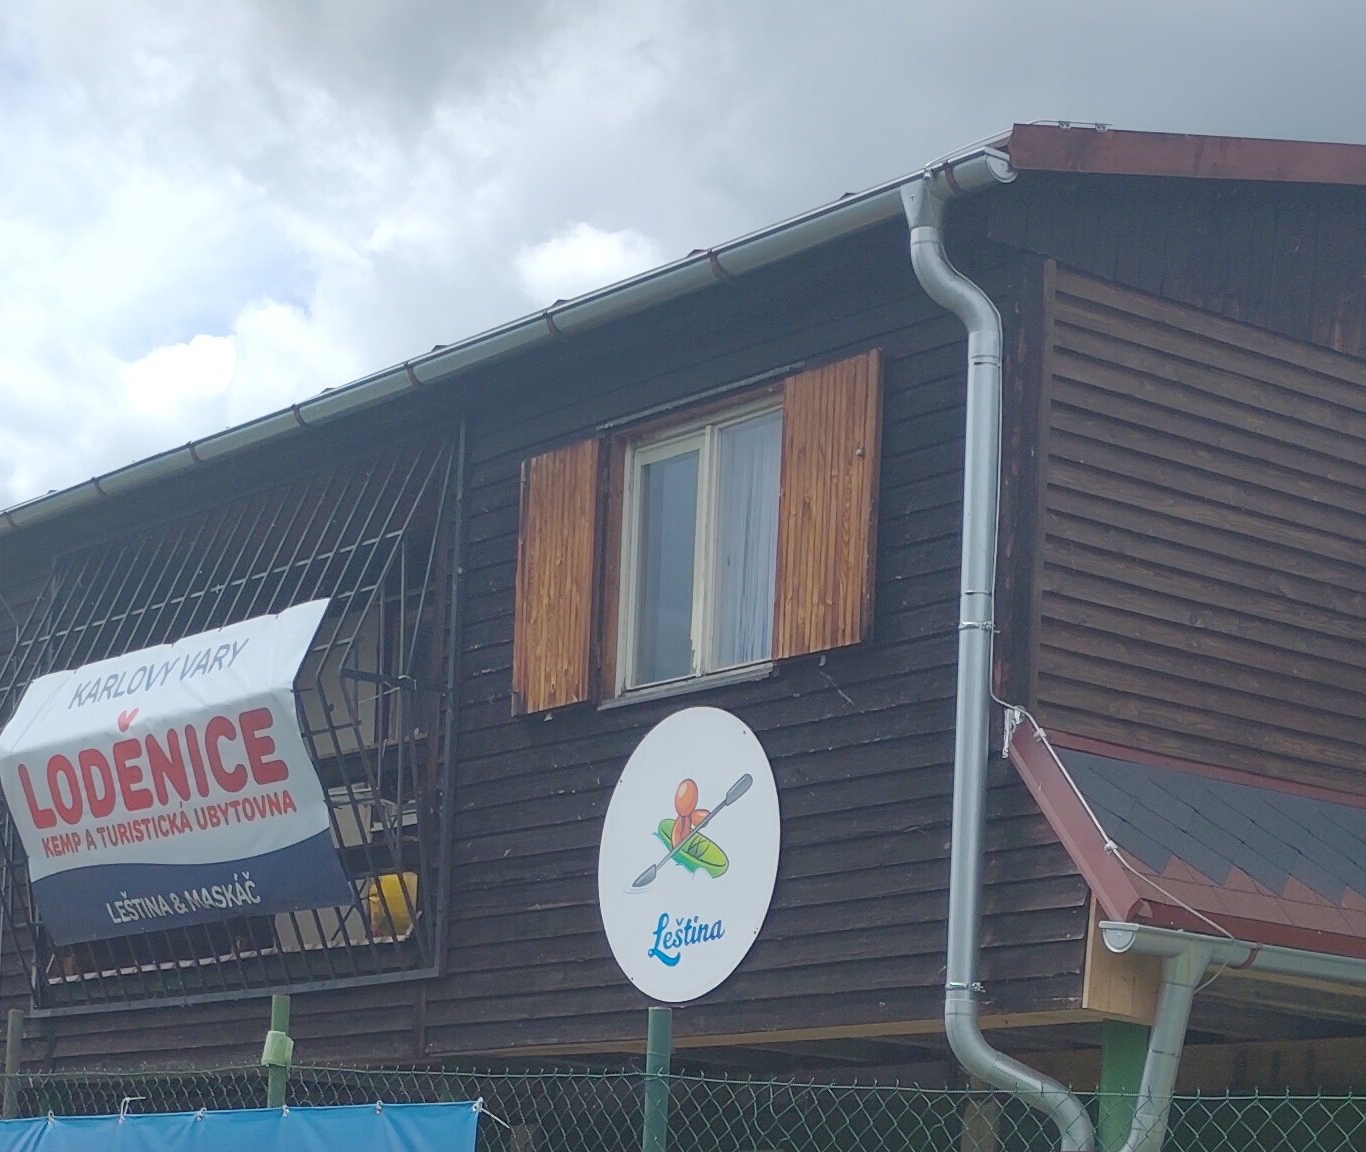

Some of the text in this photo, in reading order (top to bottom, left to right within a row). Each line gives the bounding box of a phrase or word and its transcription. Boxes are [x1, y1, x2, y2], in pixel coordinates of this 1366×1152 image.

[68, 638, 249, 709] KARLOVY VARY
[18, 707, 289, 829] LODĚNICE
[42, 790, 297, 858] KEMP A TURISTICKÁ UBYTOVNA
[106, 871, 261, 923] LEŠTINA & MASKÁČ
[647, 912, 725, 967] Leština
